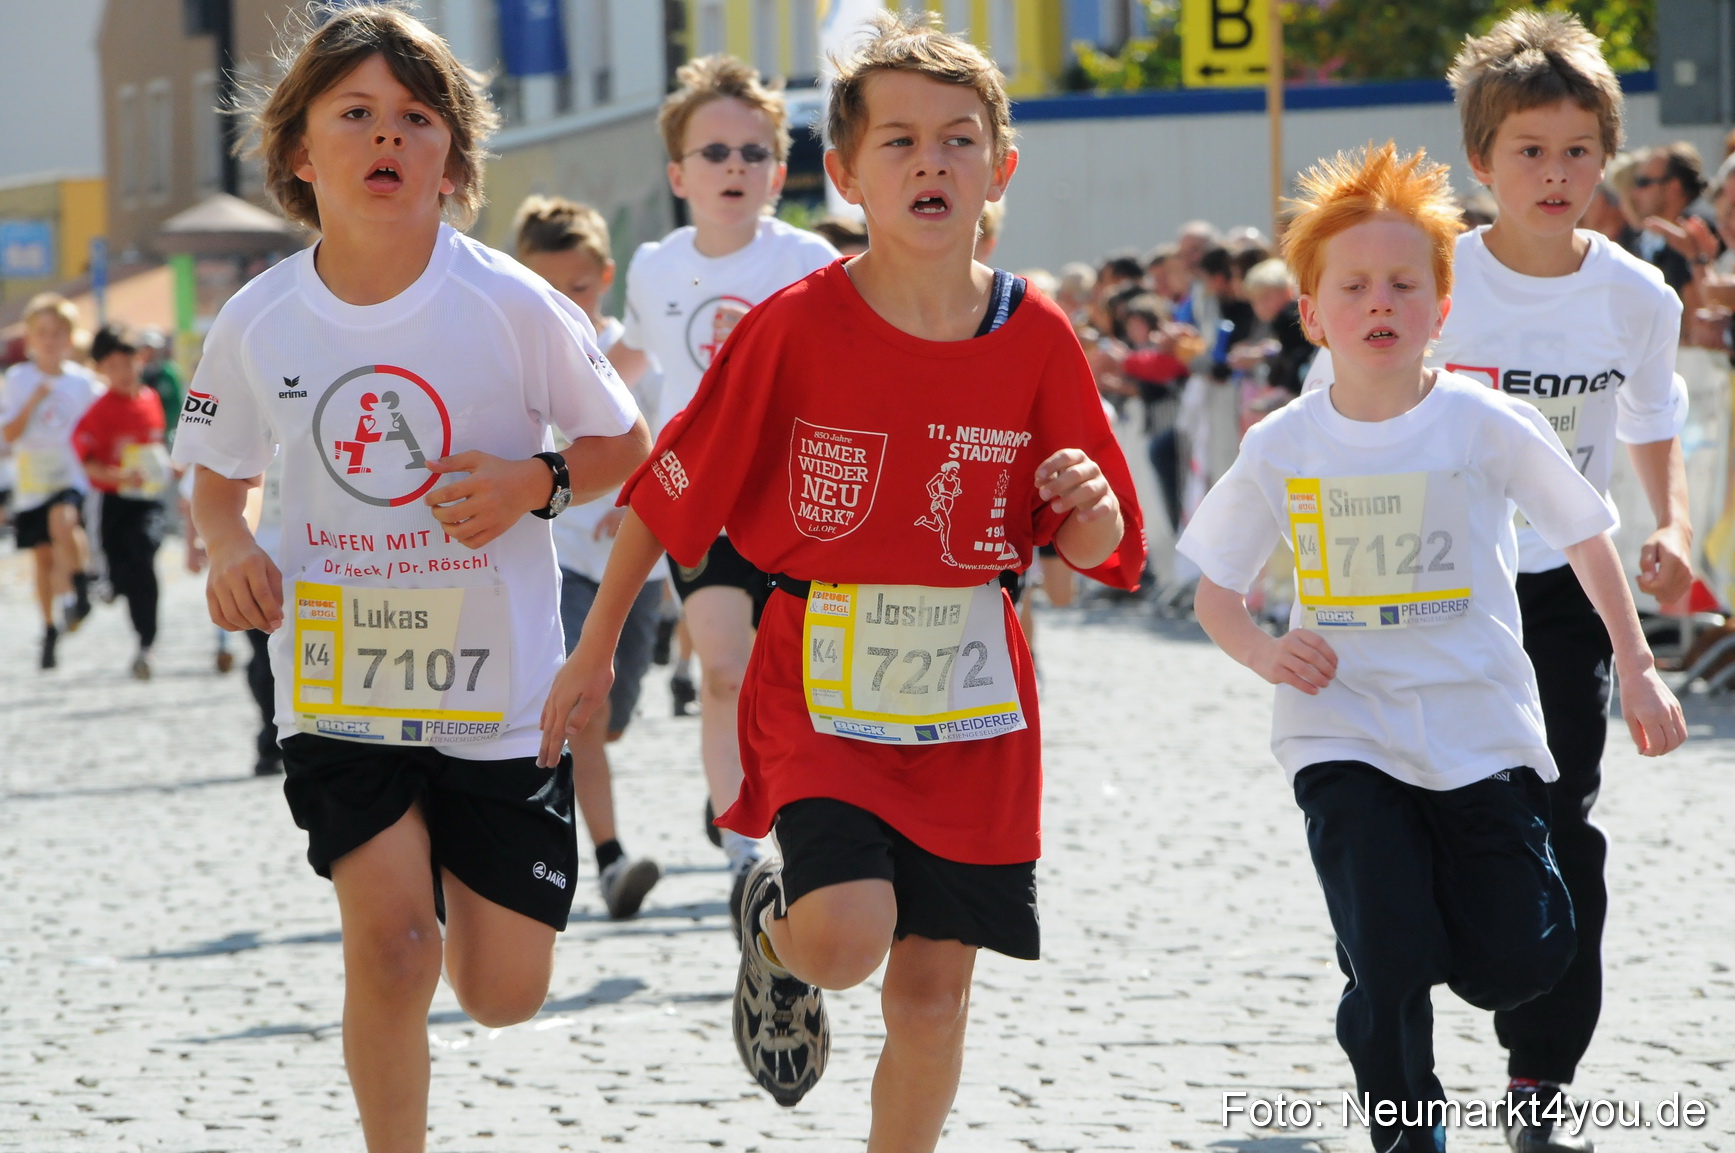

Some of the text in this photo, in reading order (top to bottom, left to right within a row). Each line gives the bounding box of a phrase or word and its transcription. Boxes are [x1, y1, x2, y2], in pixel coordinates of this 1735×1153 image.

[1210, 0, 1253, 49] B
[278, 390, 308, 399] erima
[813, 430, 853, 444] 850 Jahre
[927, 423, 952, 441] 11.
[801, 437, 867, 464] IMMER
[797, 455, 869, 482] WIEDER
[801, 473, 862, 508] NEU
[1328, 488, 1401, 517] Simon
[797, 500, 855, 526] MARKT
[386, 530, 431, 551] MIT
[1298, 534, 1317, 556] K4
[324, 553, 489, 579] Dr. Heck / Dr. Röschl
[1335, 530, 1455, 578] 7122
[352, 598, 429, 630] Lukas
[866, 593, 962, 628] Joshua
[1316, 610, 1355, 622] BOCK
[1401, 599, 1470, 617] PFLEIDERER
[304, 642, 330, 666] K4
[812, 638, 838, 664] K4
[357, 648, 490, 692] 7107
[867, 640, 994, 695] 7272
[316, 719, 370, 734] BOCK
[425, 721, 500, 735] PFLEIDERER
[833, 720, 886, 736] BOCK
[938, 712, 1021, 734] PFLEIDERER
[545, 870, 566, 890] JAKO
